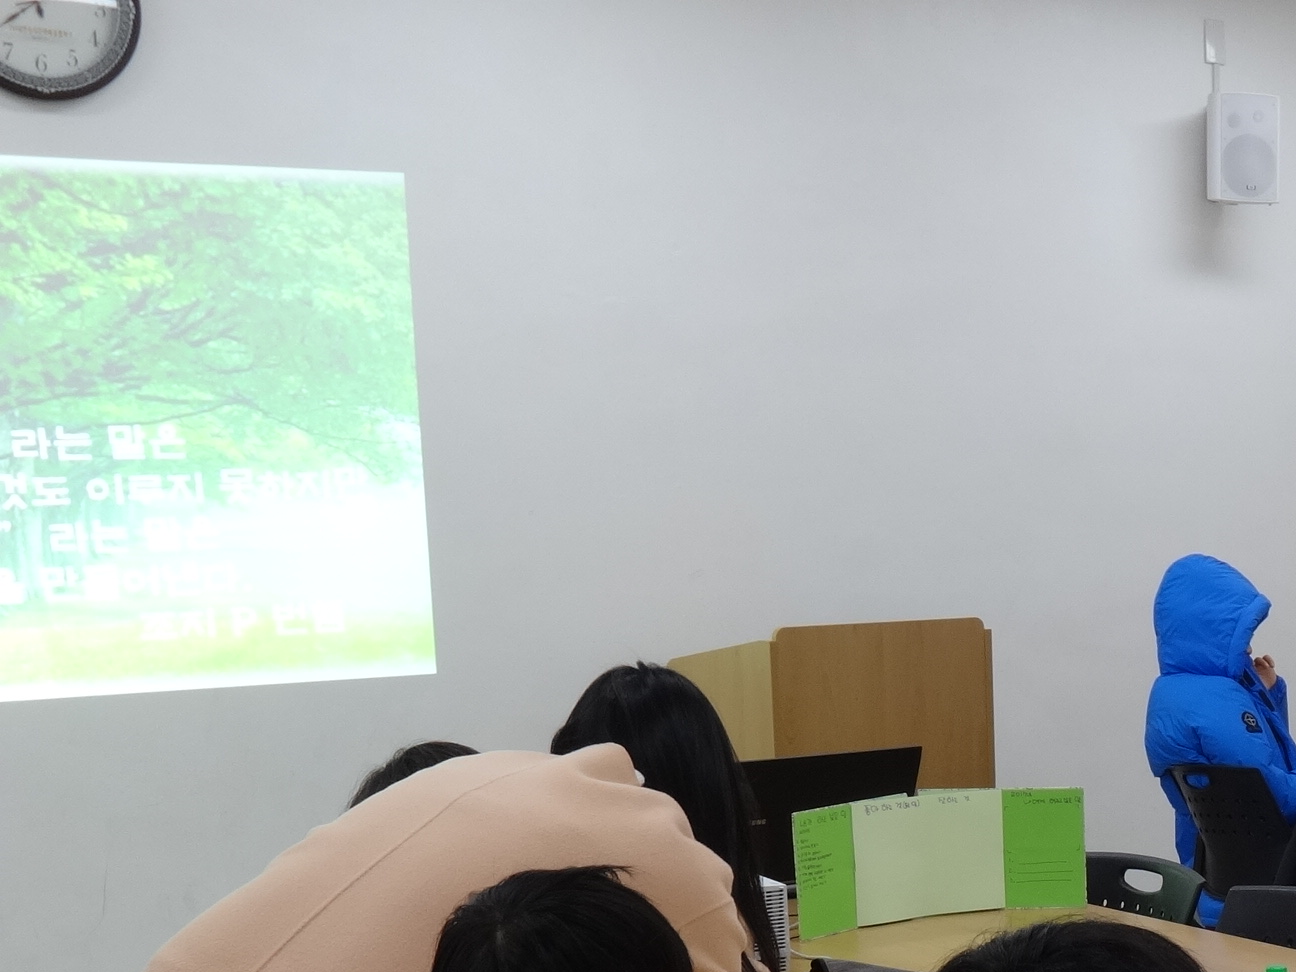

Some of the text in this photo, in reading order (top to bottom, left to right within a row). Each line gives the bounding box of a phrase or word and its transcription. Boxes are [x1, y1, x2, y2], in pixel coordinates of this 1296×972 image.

[35, 53, 48, 72] 6
[66, 49, 78, 67] 5
[10, 423, 187, 460] 라는 말은
[86, 472, 205, 506] 이르지
[48, 518, 129, 554] 라는
[231, 606, 256, 638] P
